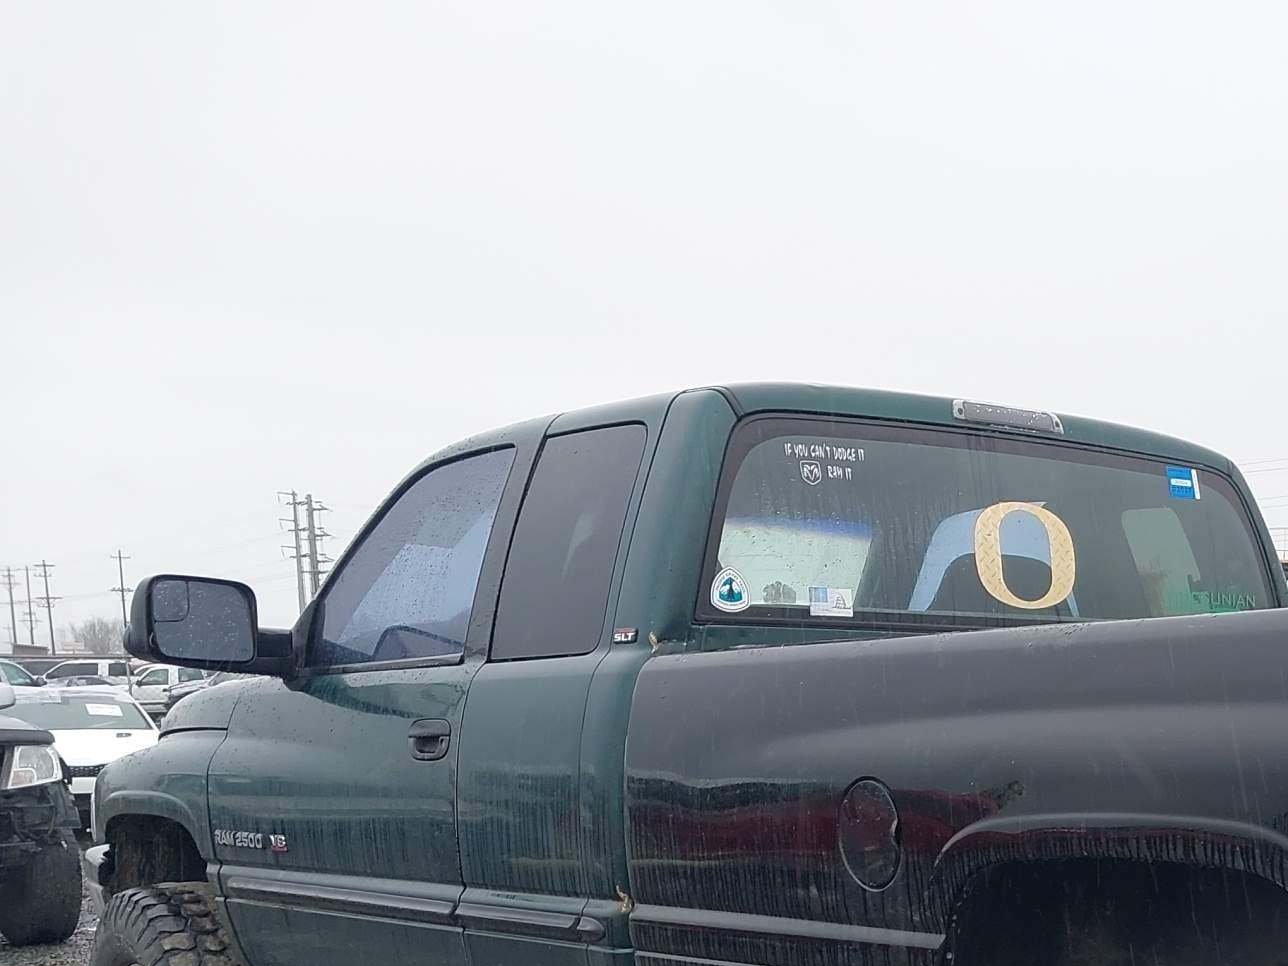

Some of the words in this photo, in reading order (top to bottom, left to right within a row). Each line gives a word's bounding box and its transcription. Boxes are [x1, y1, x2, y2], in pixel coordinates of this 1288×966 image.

[784, 442, 792, 457] IF
[793, 443, 808, 459] YOU
[810, 442, 831, 459] CAN'T
[832, 447, 856, 462] DODGE
[858, 448, 865, 461] IT
[827, 465, 843, 479] RAM
[845, 467, 852, 481] IT
[974, 501, 1076, 609] O
[613, 632, 635, 642] SLT
[214, 829, 235, 847] RAM
[235, 831, 263, 849] 2500
